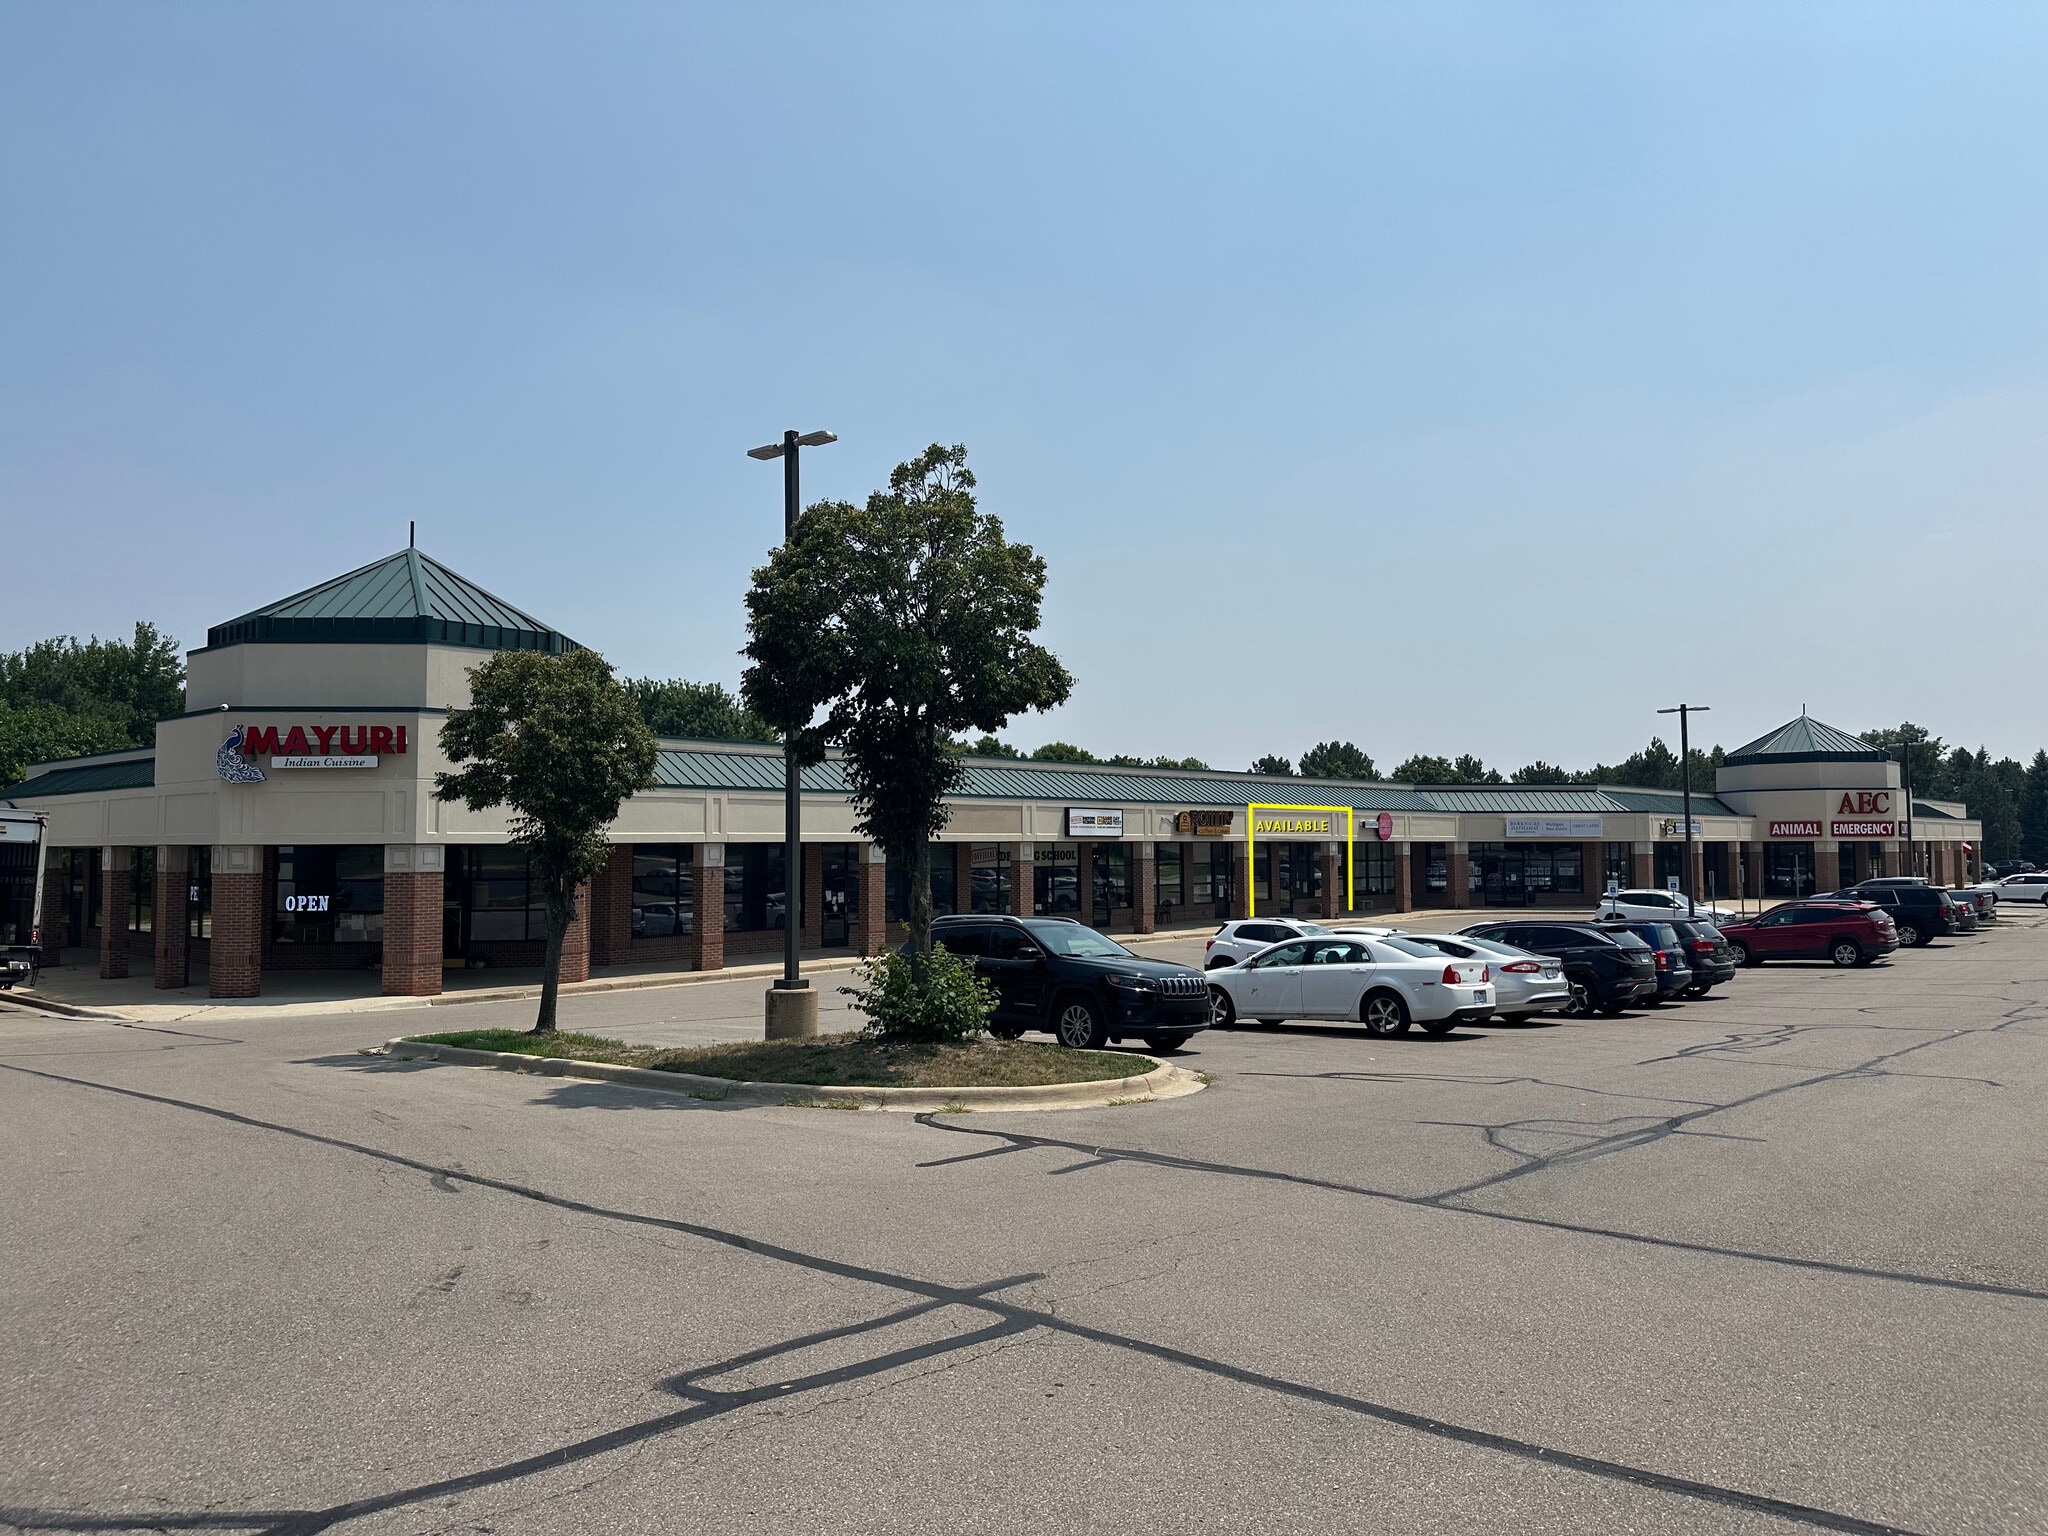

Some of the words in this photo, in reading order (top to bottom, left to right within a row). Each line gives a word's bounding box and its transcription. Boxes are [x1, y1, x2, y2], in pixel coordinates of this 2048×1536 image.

[244, 725, 407, 755] MAYURI
[284, 757, 320, 767] Indian
[324, 757, 366, 767] Cuisine
[1837, 792, 1890, 814] AEC
[1772, 823, 1820, 835] ANIMAL
[1833, 823, 1893, 835] EMERGENCY
[973, 849, 996, 862] OFFICIAL
[1042, 850, 1077, 861] SCHOOL
[285, 895, 330, 912] OPEN
